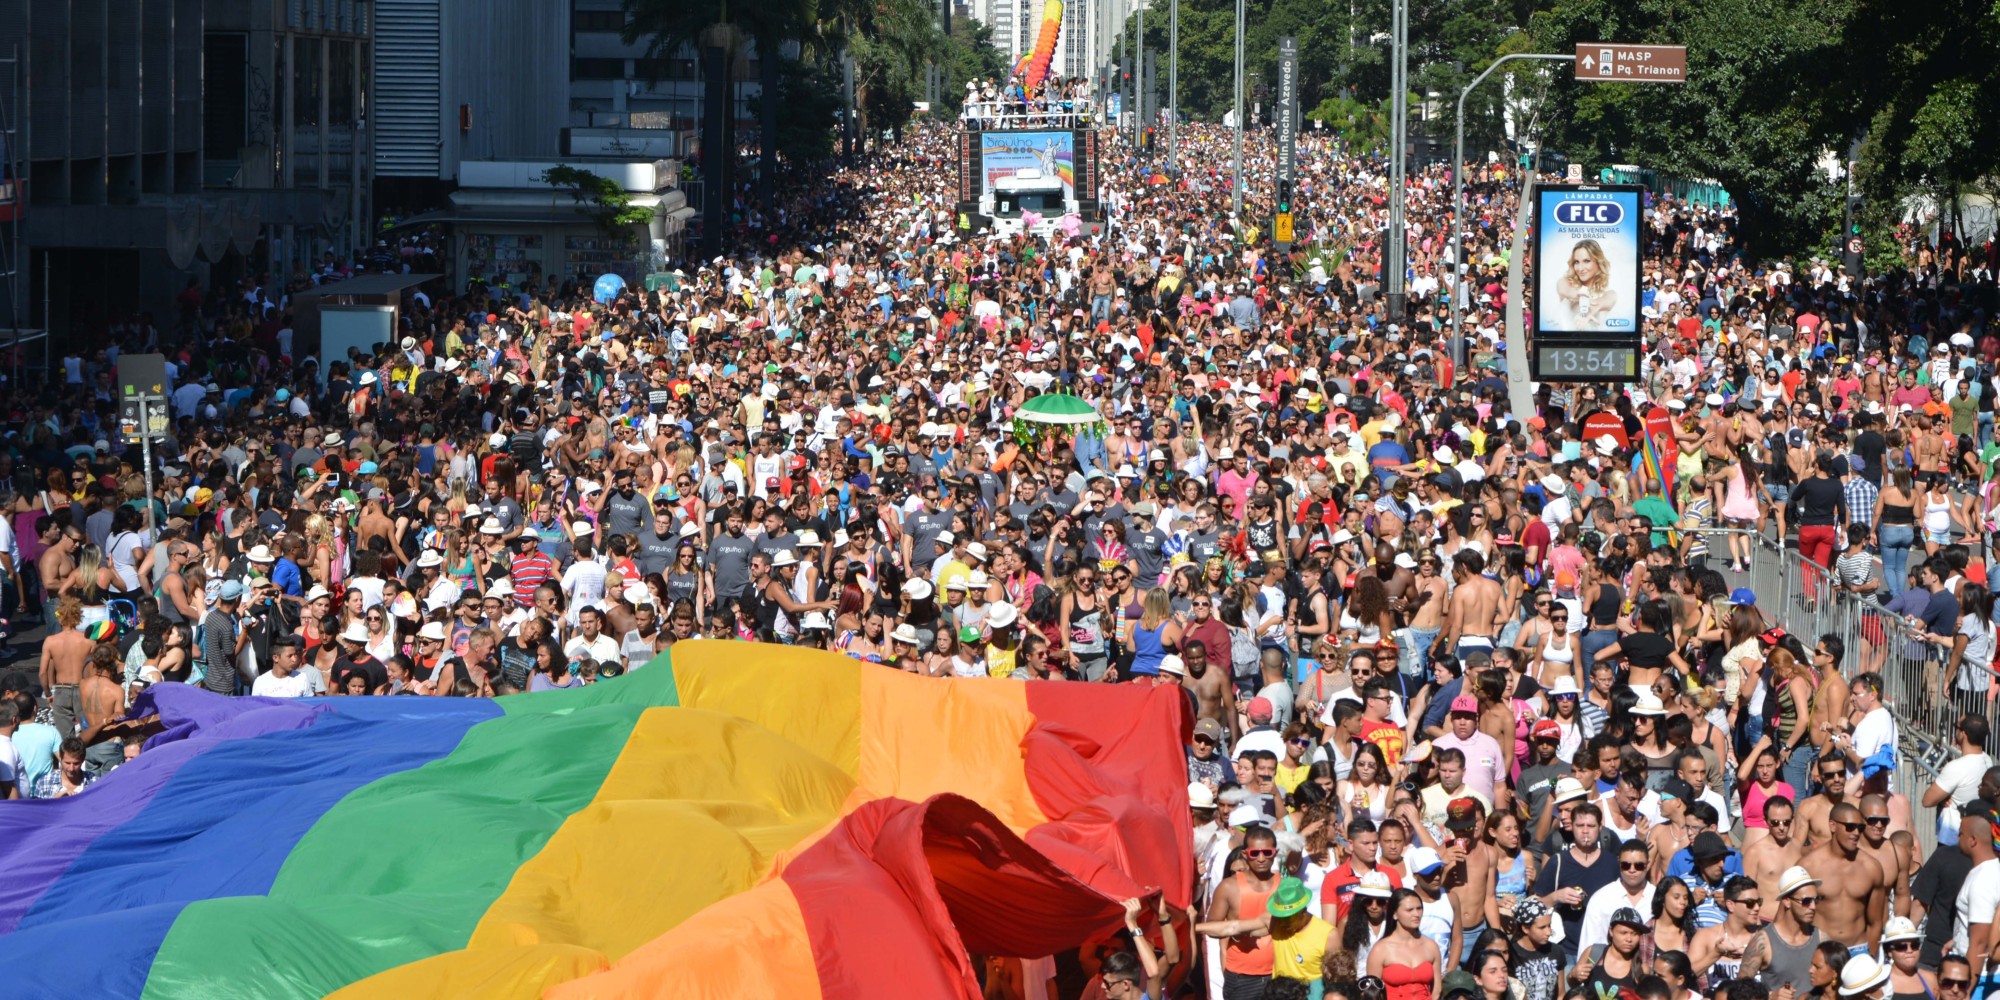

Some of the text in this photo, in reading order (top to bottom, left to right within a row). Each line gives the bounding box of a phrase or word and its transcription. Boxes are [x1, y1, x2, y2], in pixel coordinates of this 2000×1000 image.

[1617, 51, 1652, 61] MASP
[1617, 65, 1680, 76] Pq. Trianon
[1280, 60, 1292, 181] Al. Min. Rocha Azevedo
[1570, 205, 1608, 222] FLC
[1550, 350, 1616, 372] 13:54
[614, 503, 636, 511] orgulho
[921, 522, 941, 530] orgulho
[649, 544, 672, 553] orgulho
[1132, 542, 1152, 550] orgulho
[1196, 541, 1216, 549] orgulh
[719, 546, 742, 554] orgulho
